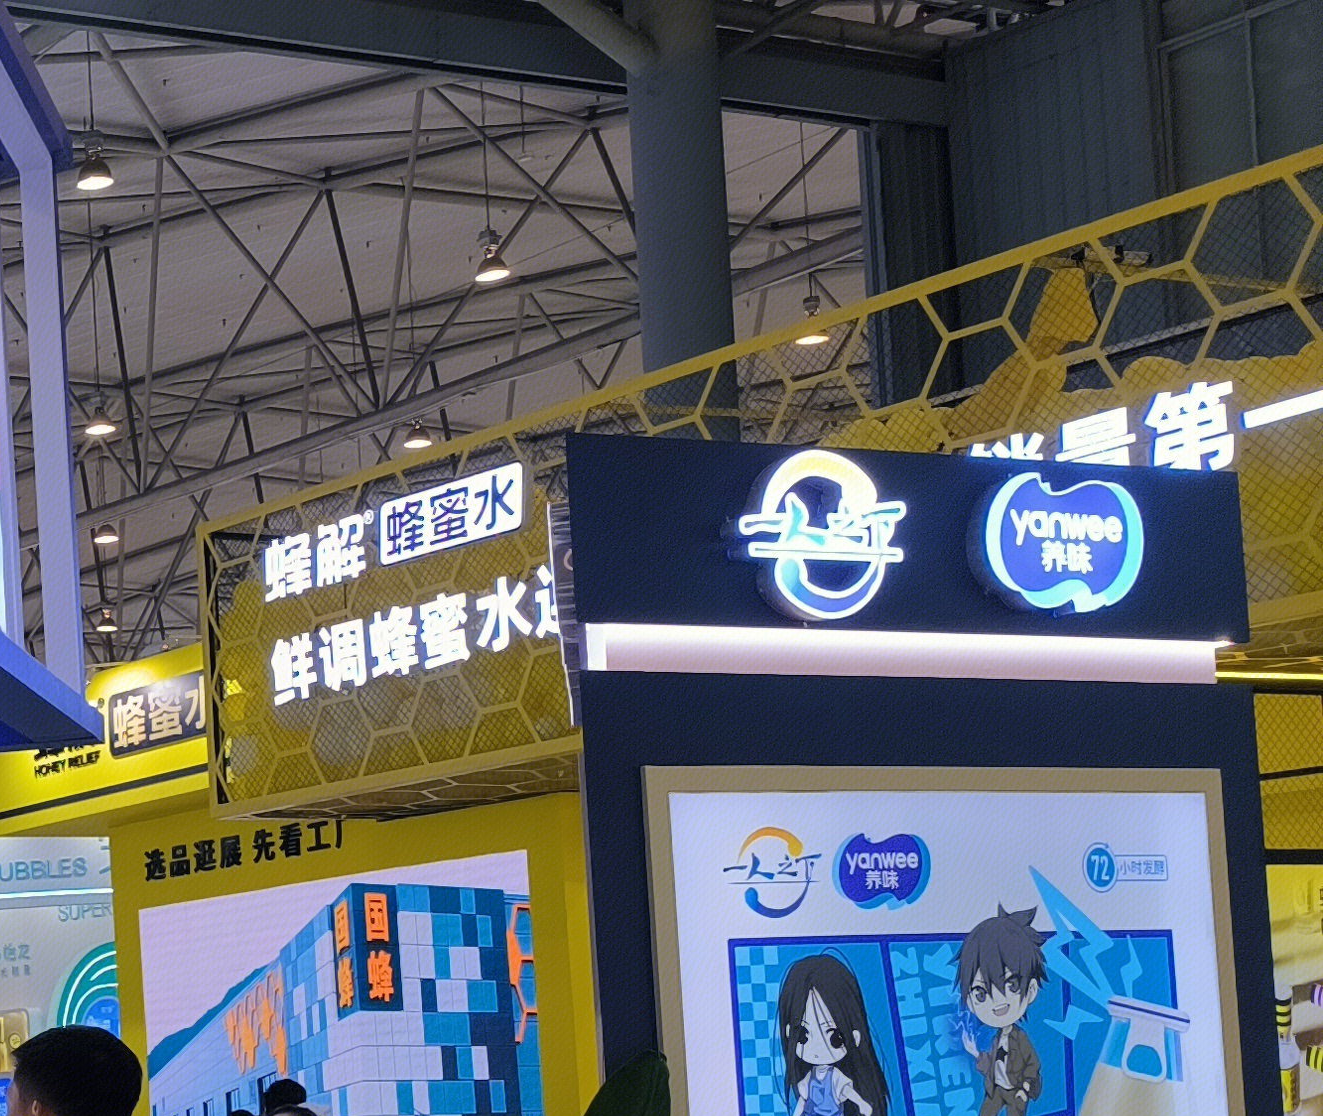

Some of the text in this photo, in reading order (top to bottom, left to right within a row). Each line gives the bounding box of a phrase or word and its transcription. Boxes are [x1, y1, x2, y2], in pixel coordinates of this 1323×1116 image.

[970, 381, 1323, 470] 量第一
[386, 474, 515, 556] 蜂蜜水
[1010, 508, 1123, 546] yanwee
[1041, 541, 1093, 574] 养味
[144, 834, 242, 881] 选品逛展
[723, 852, 822, 882] 一人之下
[845, 850, 919, 875] yanwee
[1090, 855, 1110, 881] 72
[865, 870, 900, 890] 养味
[364, 892, 395, 1002] 国蜂
